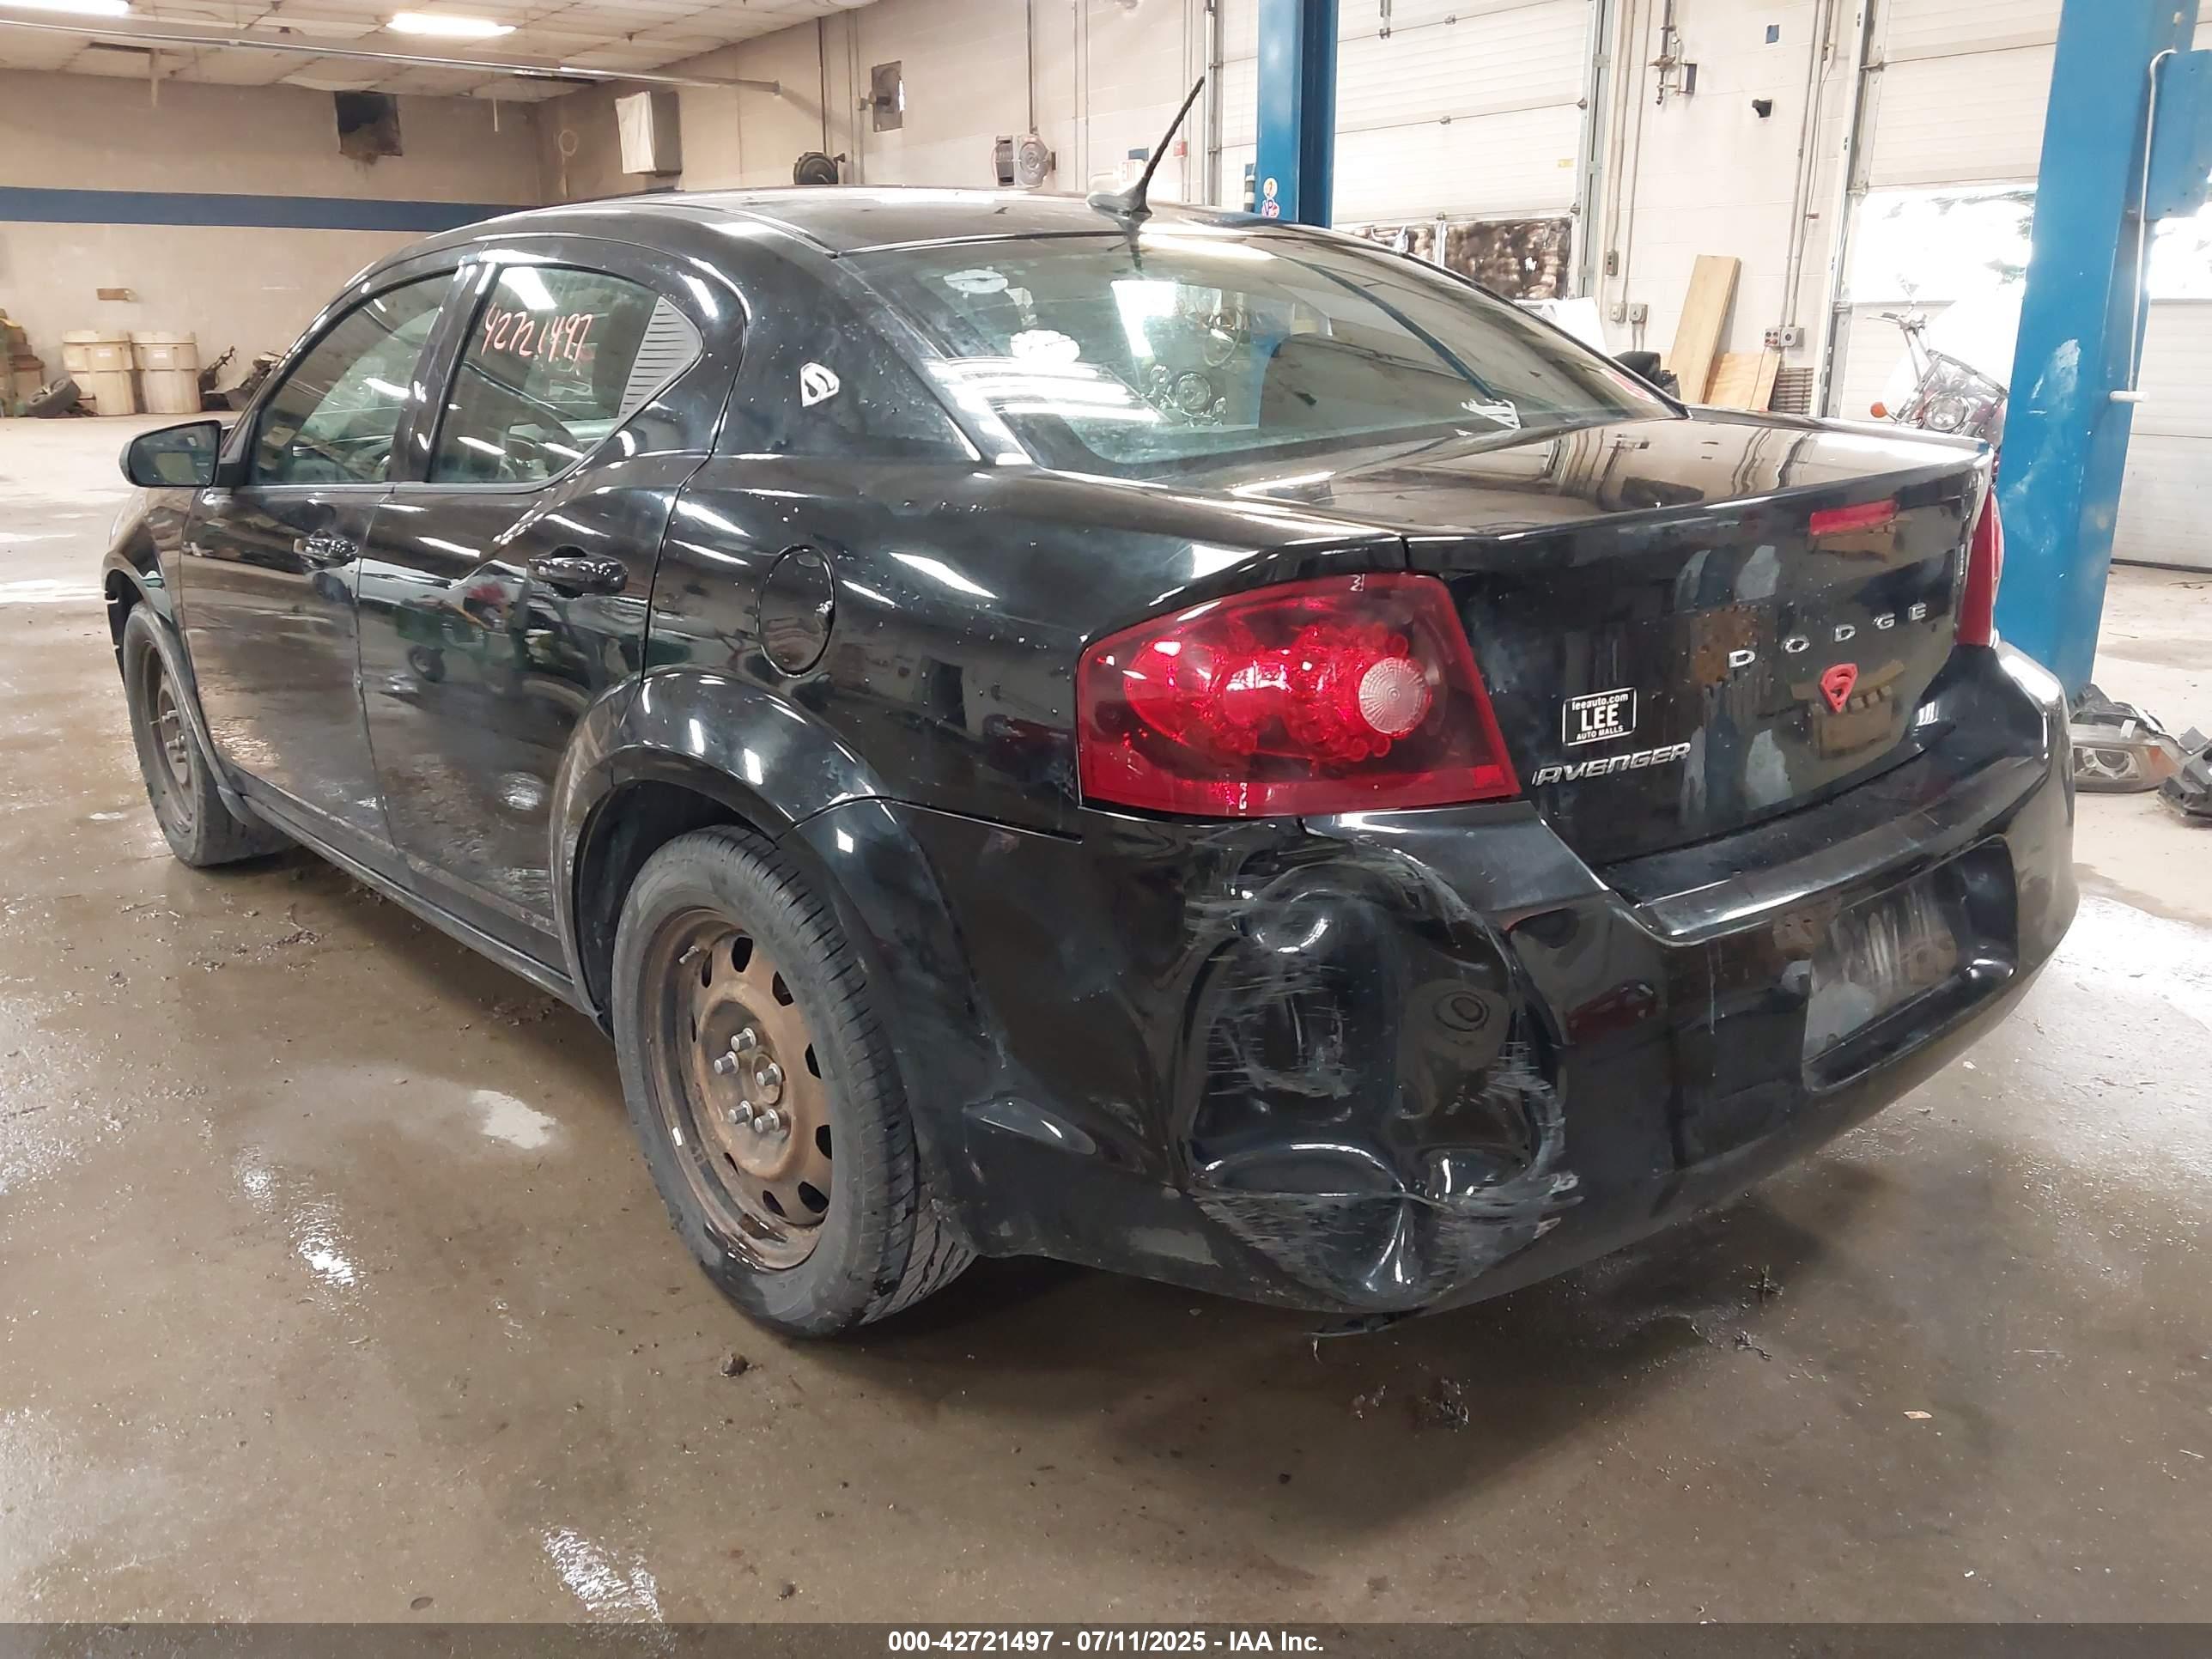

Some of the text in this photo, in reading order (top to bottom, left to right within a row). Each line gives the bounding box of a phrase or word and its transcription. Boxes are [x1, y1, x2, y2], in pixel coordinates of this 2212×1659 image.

[481, 301, 594, 363] 42721497
[1729, 602, 1926, 668] DODGE
[1571, 693, 1628, 711] leeauto.com
[1581, 703, 1620, 732] LEE
[1577, 725, 1624, 740] AUTO MALLS
[1532, 742, 1691, 787] AVENGER
